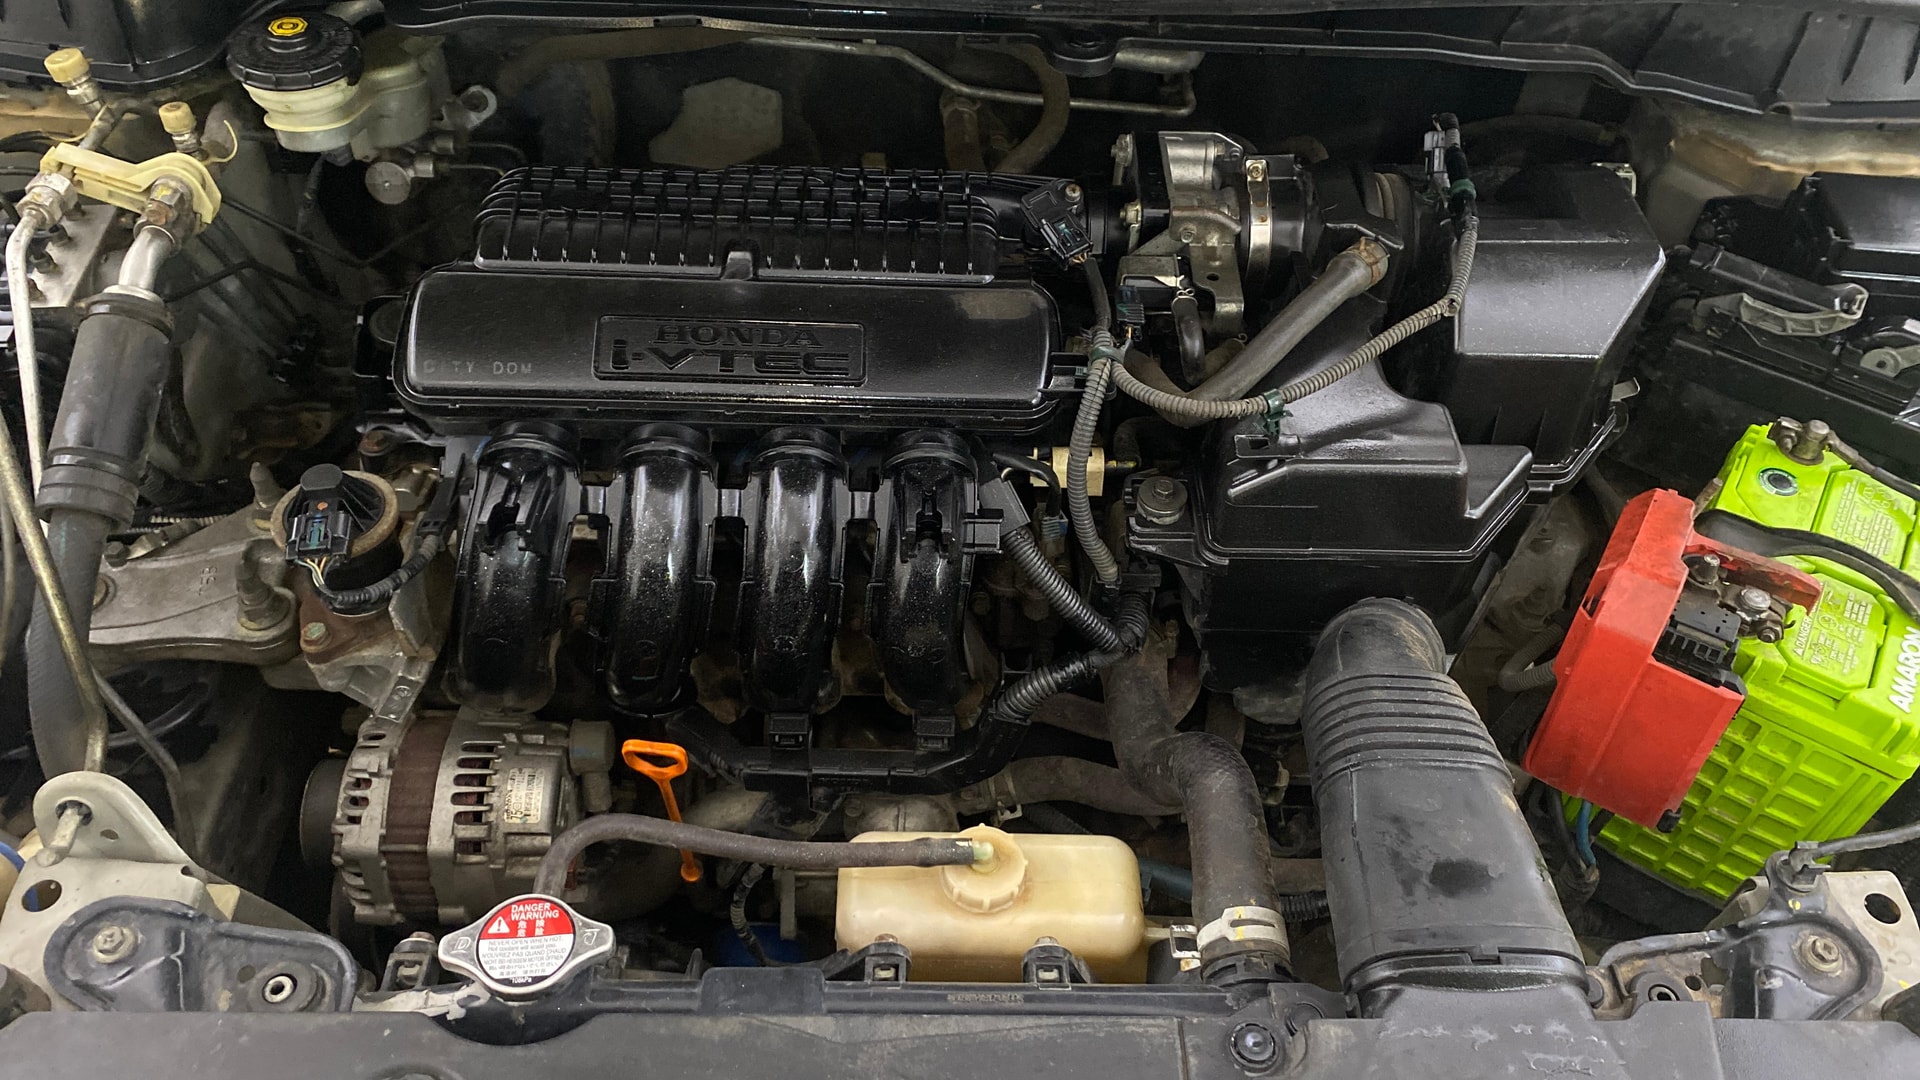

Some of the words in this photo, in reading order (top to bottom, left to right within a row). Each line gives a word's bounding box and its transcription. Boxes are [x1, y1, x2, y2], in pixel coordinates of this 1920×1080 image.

[652, 325, 824, 348] HONDA
[611, 338, 850, 377] i-VTEC
[511, 902, 551, 913] DANGER
[511, 909, 560, 921] WARNUNG
